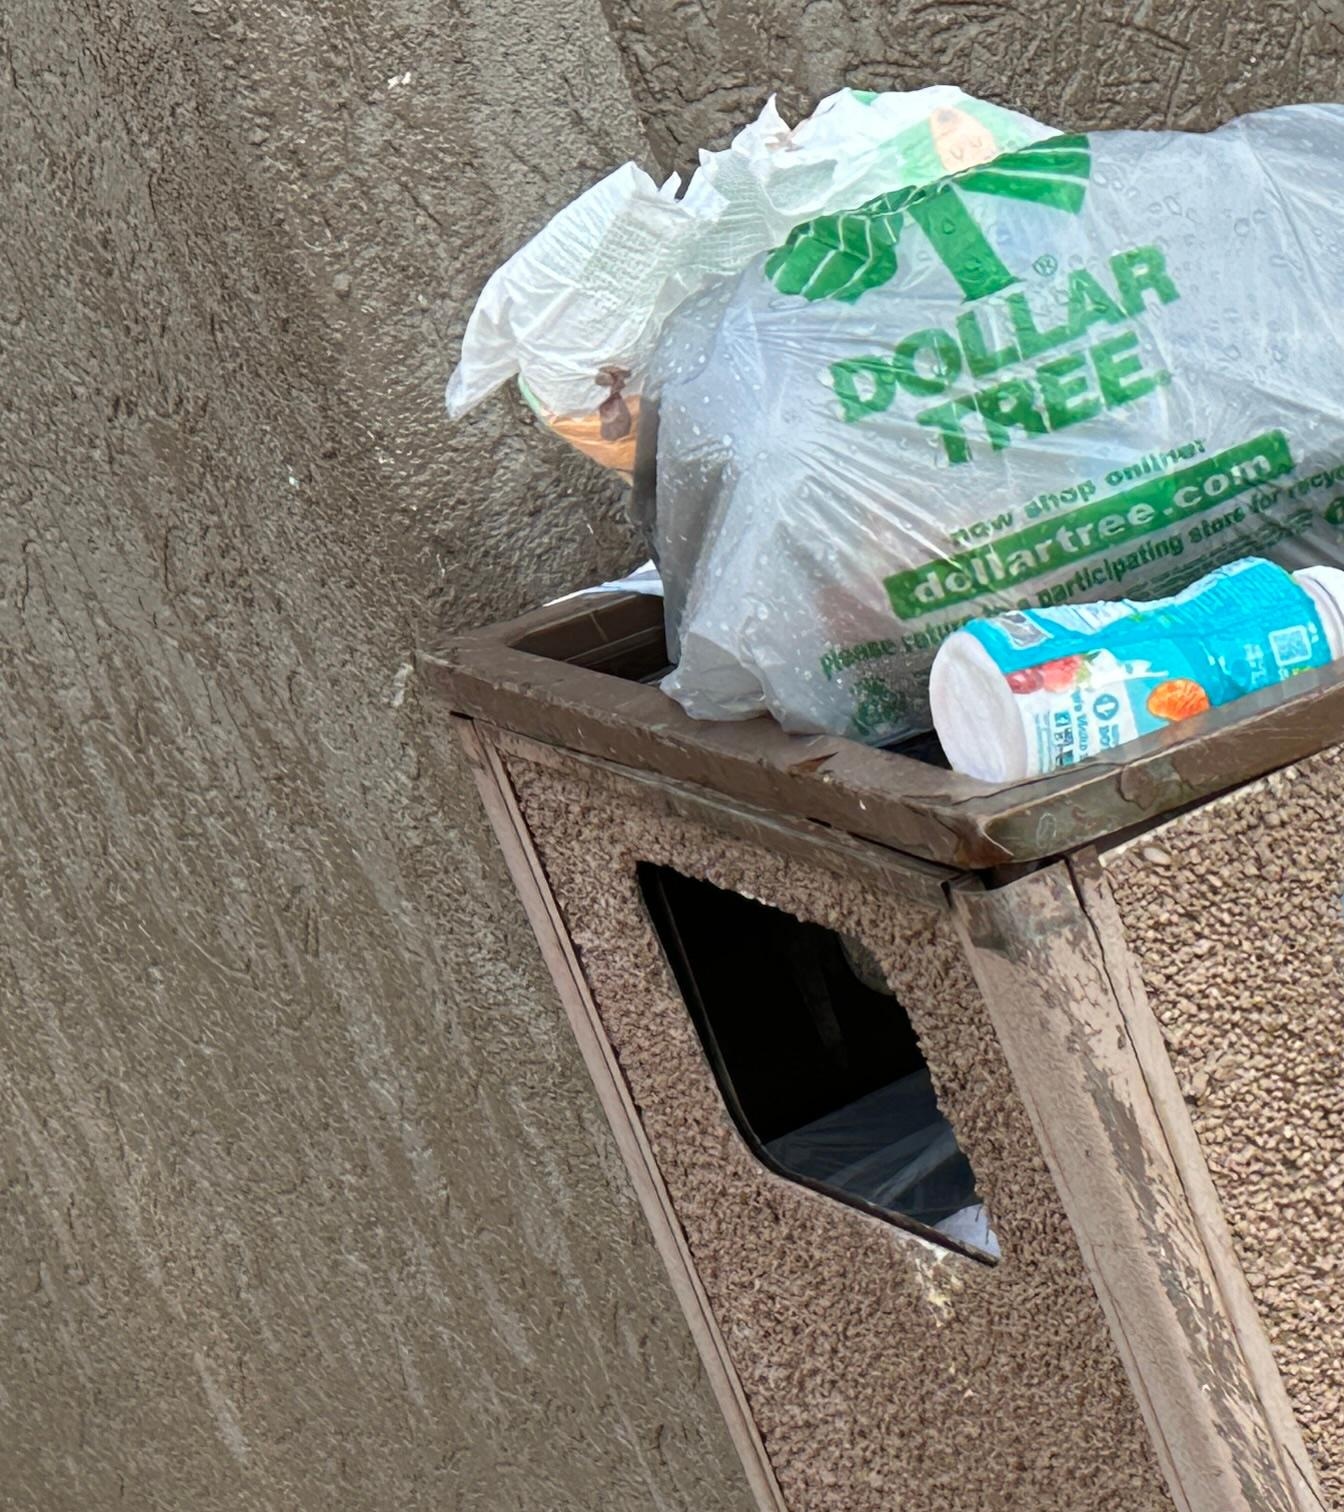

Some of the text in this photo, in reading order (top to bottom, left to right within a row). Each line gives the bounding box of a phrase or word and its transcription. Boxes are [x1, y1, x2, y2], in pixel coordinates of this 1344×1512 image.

[827, 244, 1181, 424] DOLLAR
[916, 330, 1165, 466] TREE
[913, 455, 1273, 603] dollartree.com
[950, 510, 1014, 547] now
[1023, 479, 1097, 519] shop
[1035, 533, 1185, 608] participating
[1188, 505, 1247, 543] store
